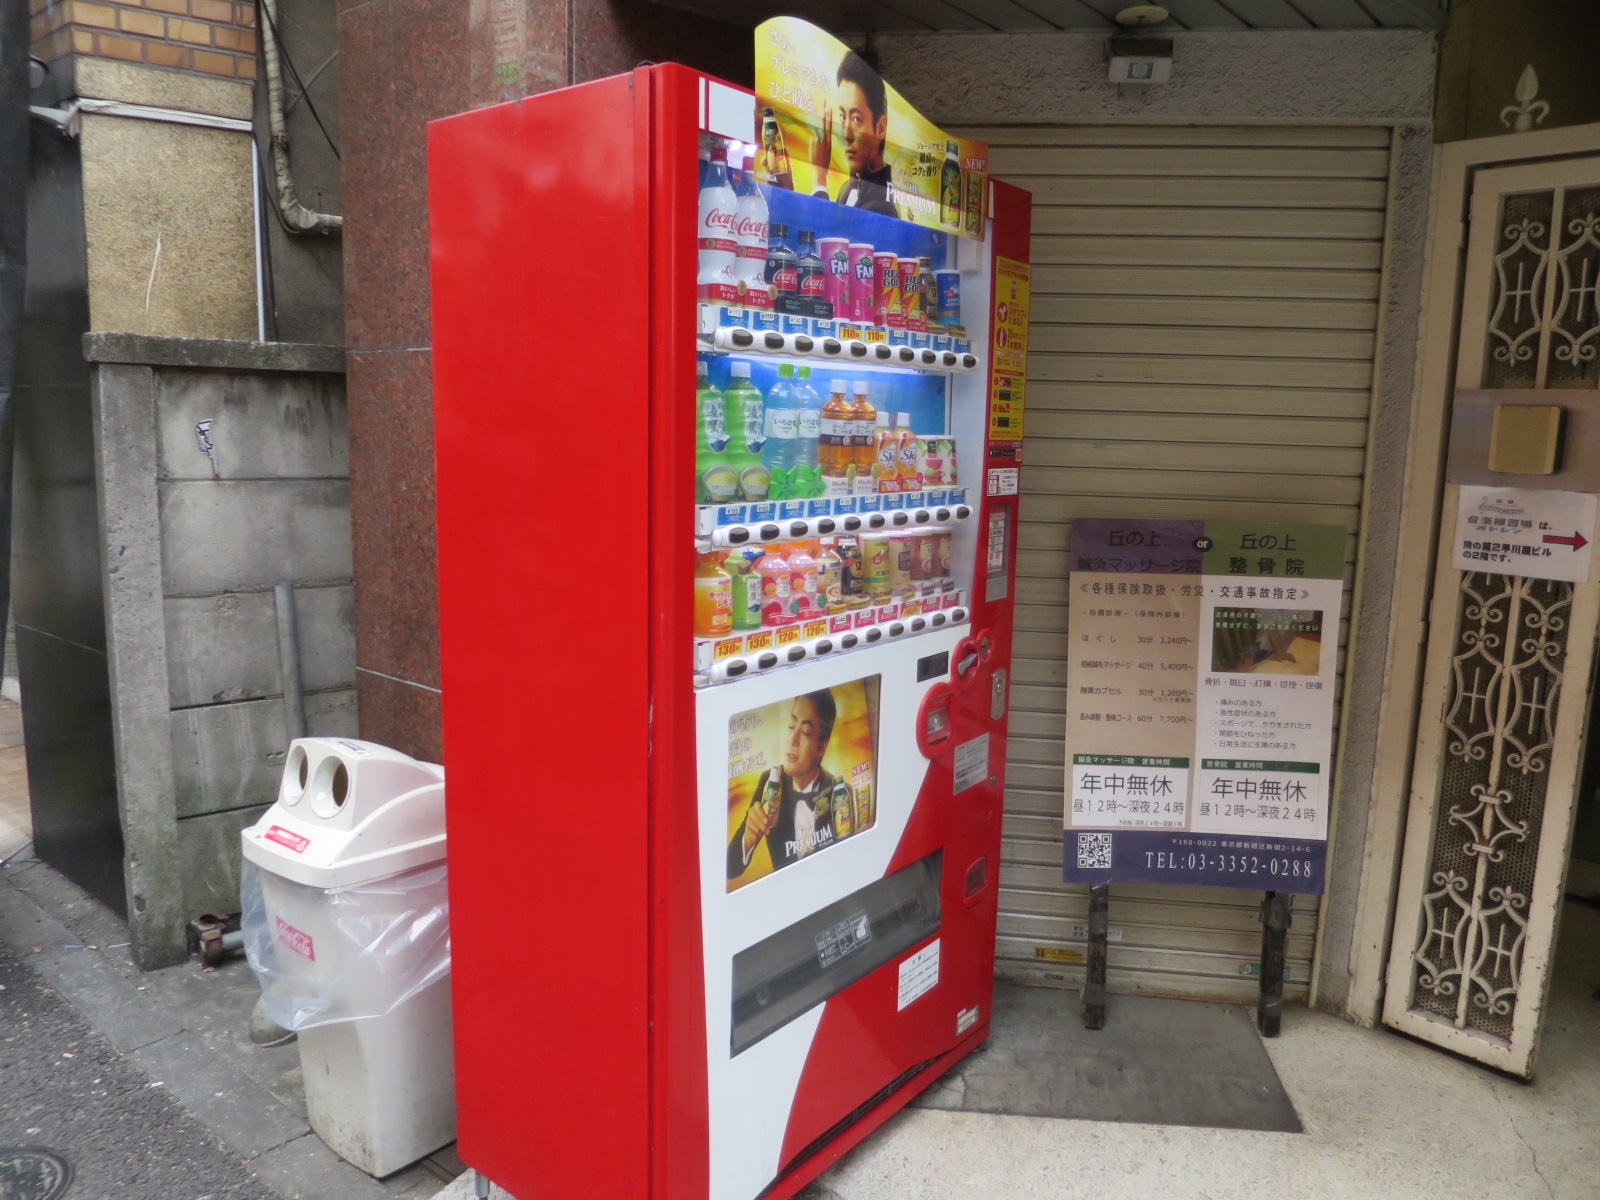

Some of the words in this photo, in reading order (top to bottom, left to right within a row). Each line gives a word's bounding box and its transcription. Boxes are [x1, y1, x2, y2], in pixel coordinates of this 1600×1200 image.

[965, 157, 986, 170] NEW!
[905, 182, 919, 194] THE
[886, 181, 937, 215] PREMIUM
[705, 207, 738, 231] Coca-C
[830, 258, 849, 275] FAN
[855, 263, 873, 279] FAN
[719, 285, 737, 293] おいしい
[749, 290, 768, 298] おいしい
[1467, 515, 1533, 529] 音楽練習場
[1108, 530, 1161, 547] 丘の上
[1197, 540, 1209, 548] or
[1239, 534, 1297, 551] 丘の上
[1077, 557, 1201, 574] 鍼灸マッサージ院
[1229, 557, 1304, 576] 整骨院
[778, 631, 798, 642] 120円
[805, 626, 825, 637] 120円
[749, 638, 770, 649] 130円
[1138, 636, 1153, 644] 30分
[718, 645, 740, 657] 130円
[1138, 662, 1153, 670] 40分
[1078, 756, 1135, 765] 鍼灸マッサージ院
[1141, 758, 1170, 766] 営業時間
[1207, 760, 1228, 769] 整骨院
[1234, 761, 1263, 770] 営業時間
[851, 761, 871, 777] NEW!
[1080, 772, 1173, 797] 年中無休
[1211, 777, 1307, 803] 年中無休
[803, 827, 816, 838] THE
[785, 823, 833, 857] PREMIUM
[1145, 851, 1312, 878] TEL:03-3352-0288
